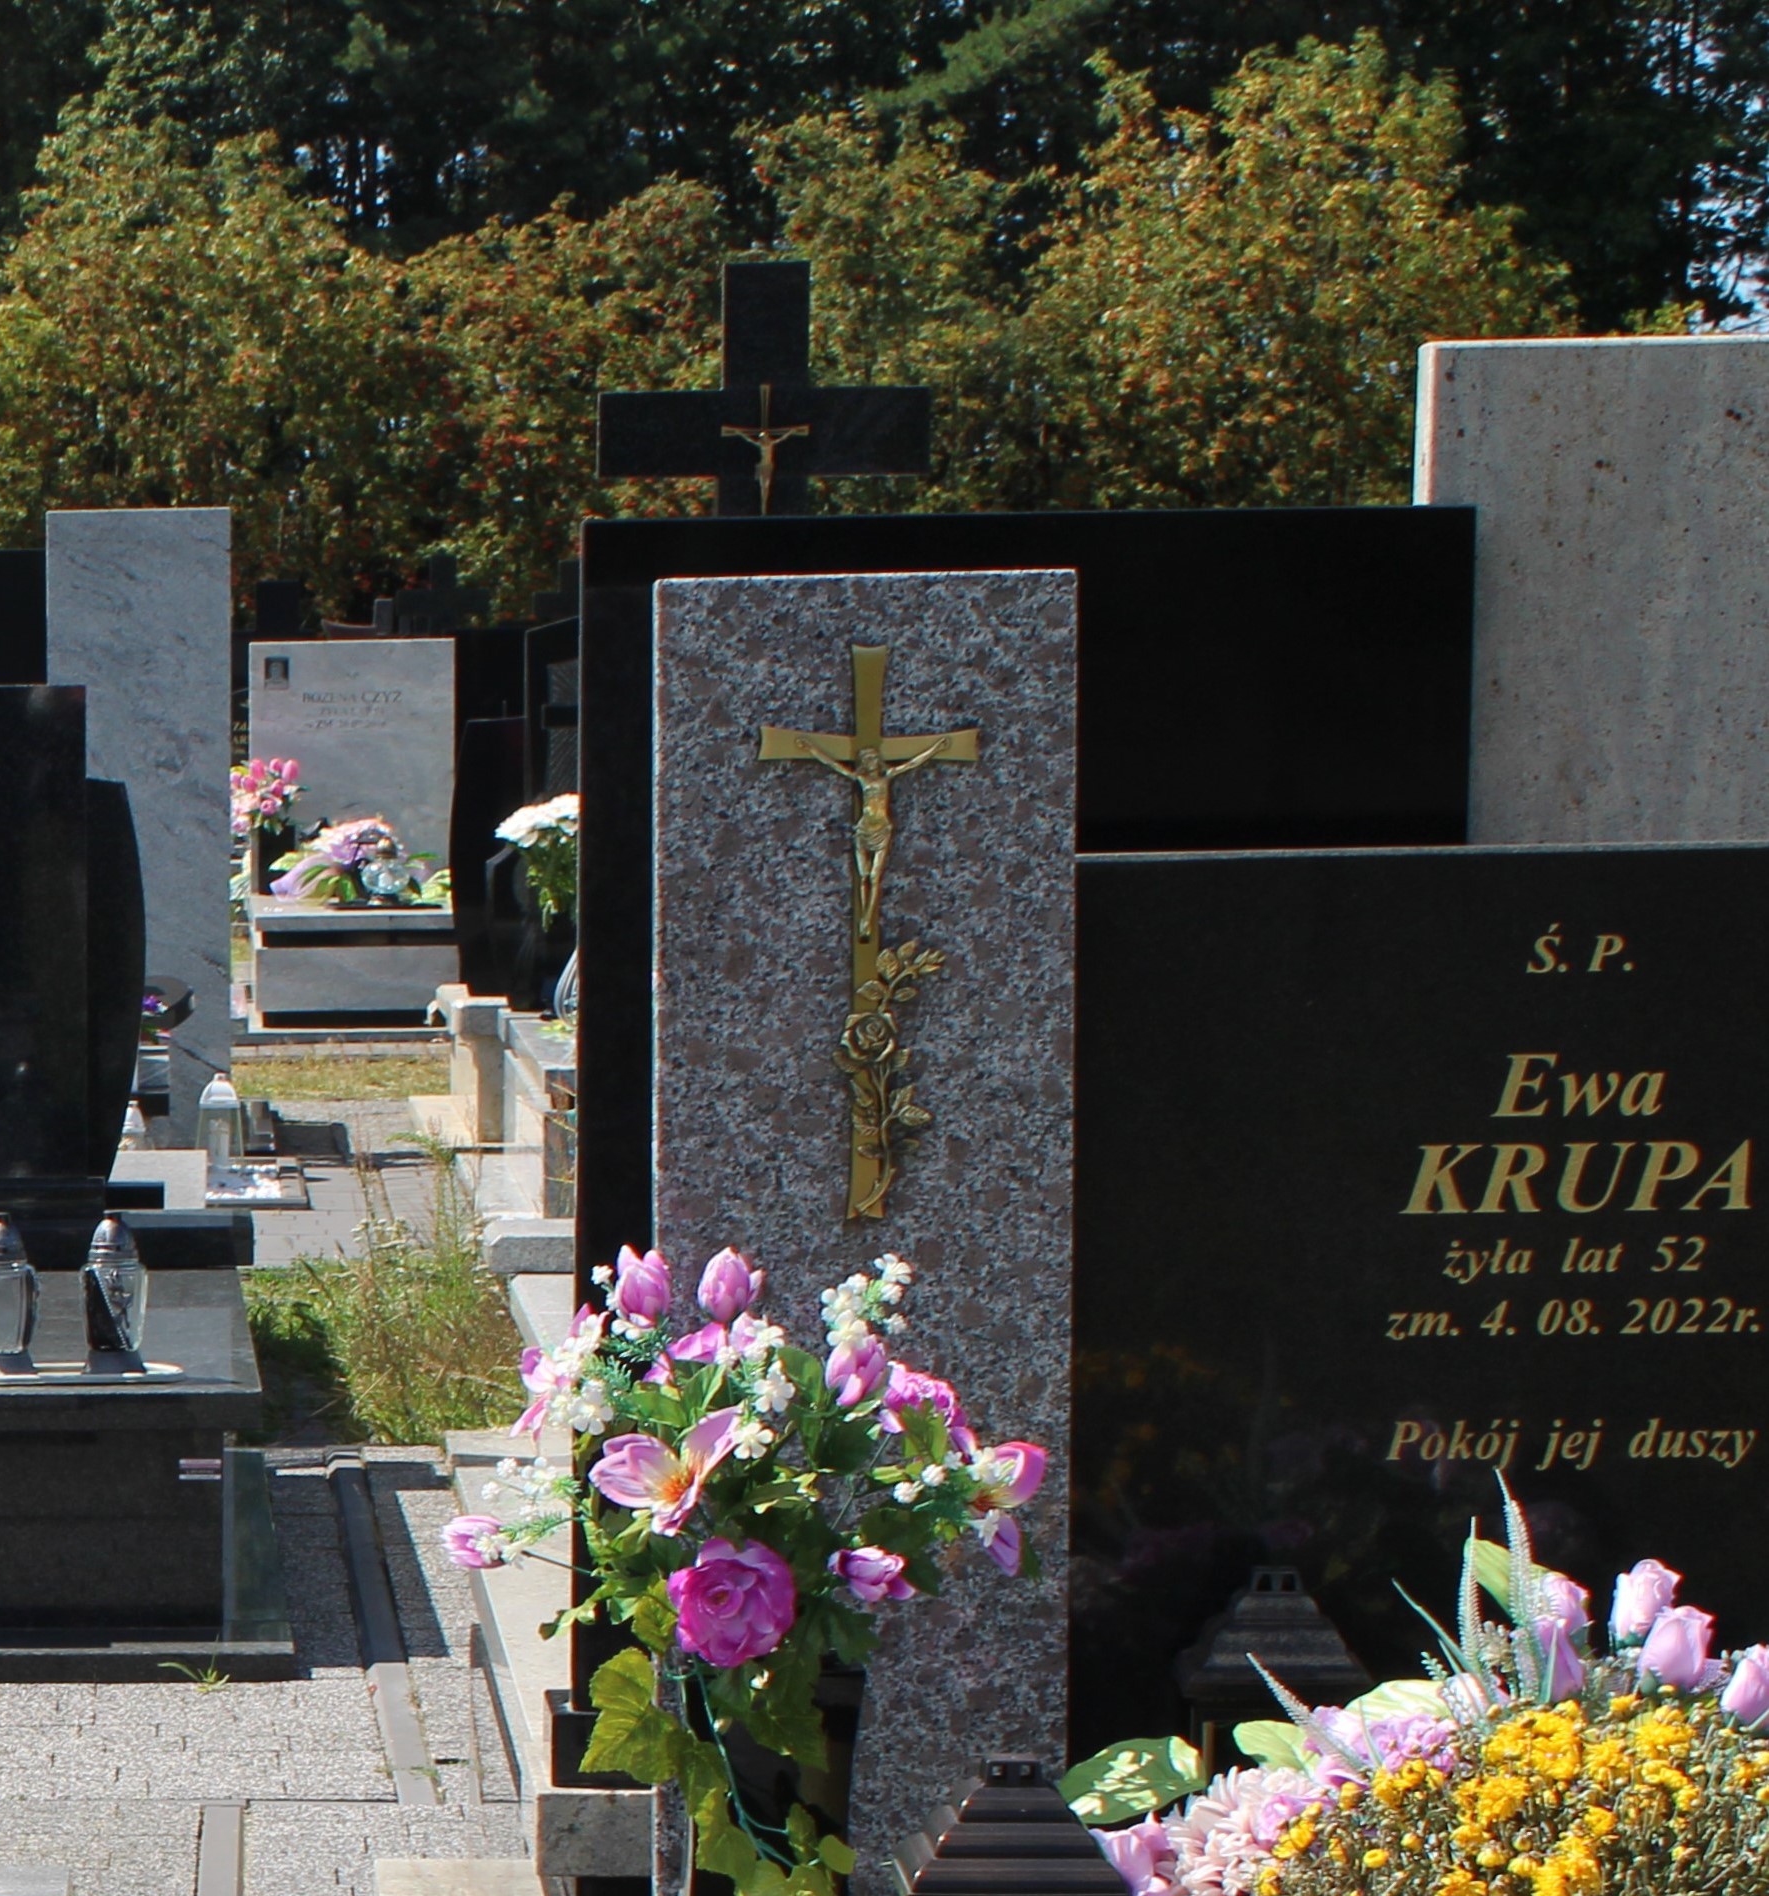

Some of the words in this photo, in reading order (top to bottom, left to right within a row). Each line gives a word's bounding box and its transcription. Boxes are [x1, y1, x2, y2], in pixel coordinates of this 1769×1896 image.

[1587, 934, 1634, 972] P.
[1490, 1052, 1664, 1117] Ewa
[1398, 1139, 1753, 1214] KRUPA
[1443, 1239, 1534, 1284] żyła
[1561, 1238, 1623, 1274] lat
[1651, 1236, 1706, 1272] 52
[1385, 1311, 1460, 1340] zm.
[1480, 1300, 1516, 1336] 4.
[1537, 1298, 1600, 1336] 08.
[1619, 1297, 1761, 1335] 2022r.
[1386, 1419, 1520, 1471] Pokój
[1536, 1418, 1603, 1471] jej
[1629, 1418, 1755, 1468] duszy
